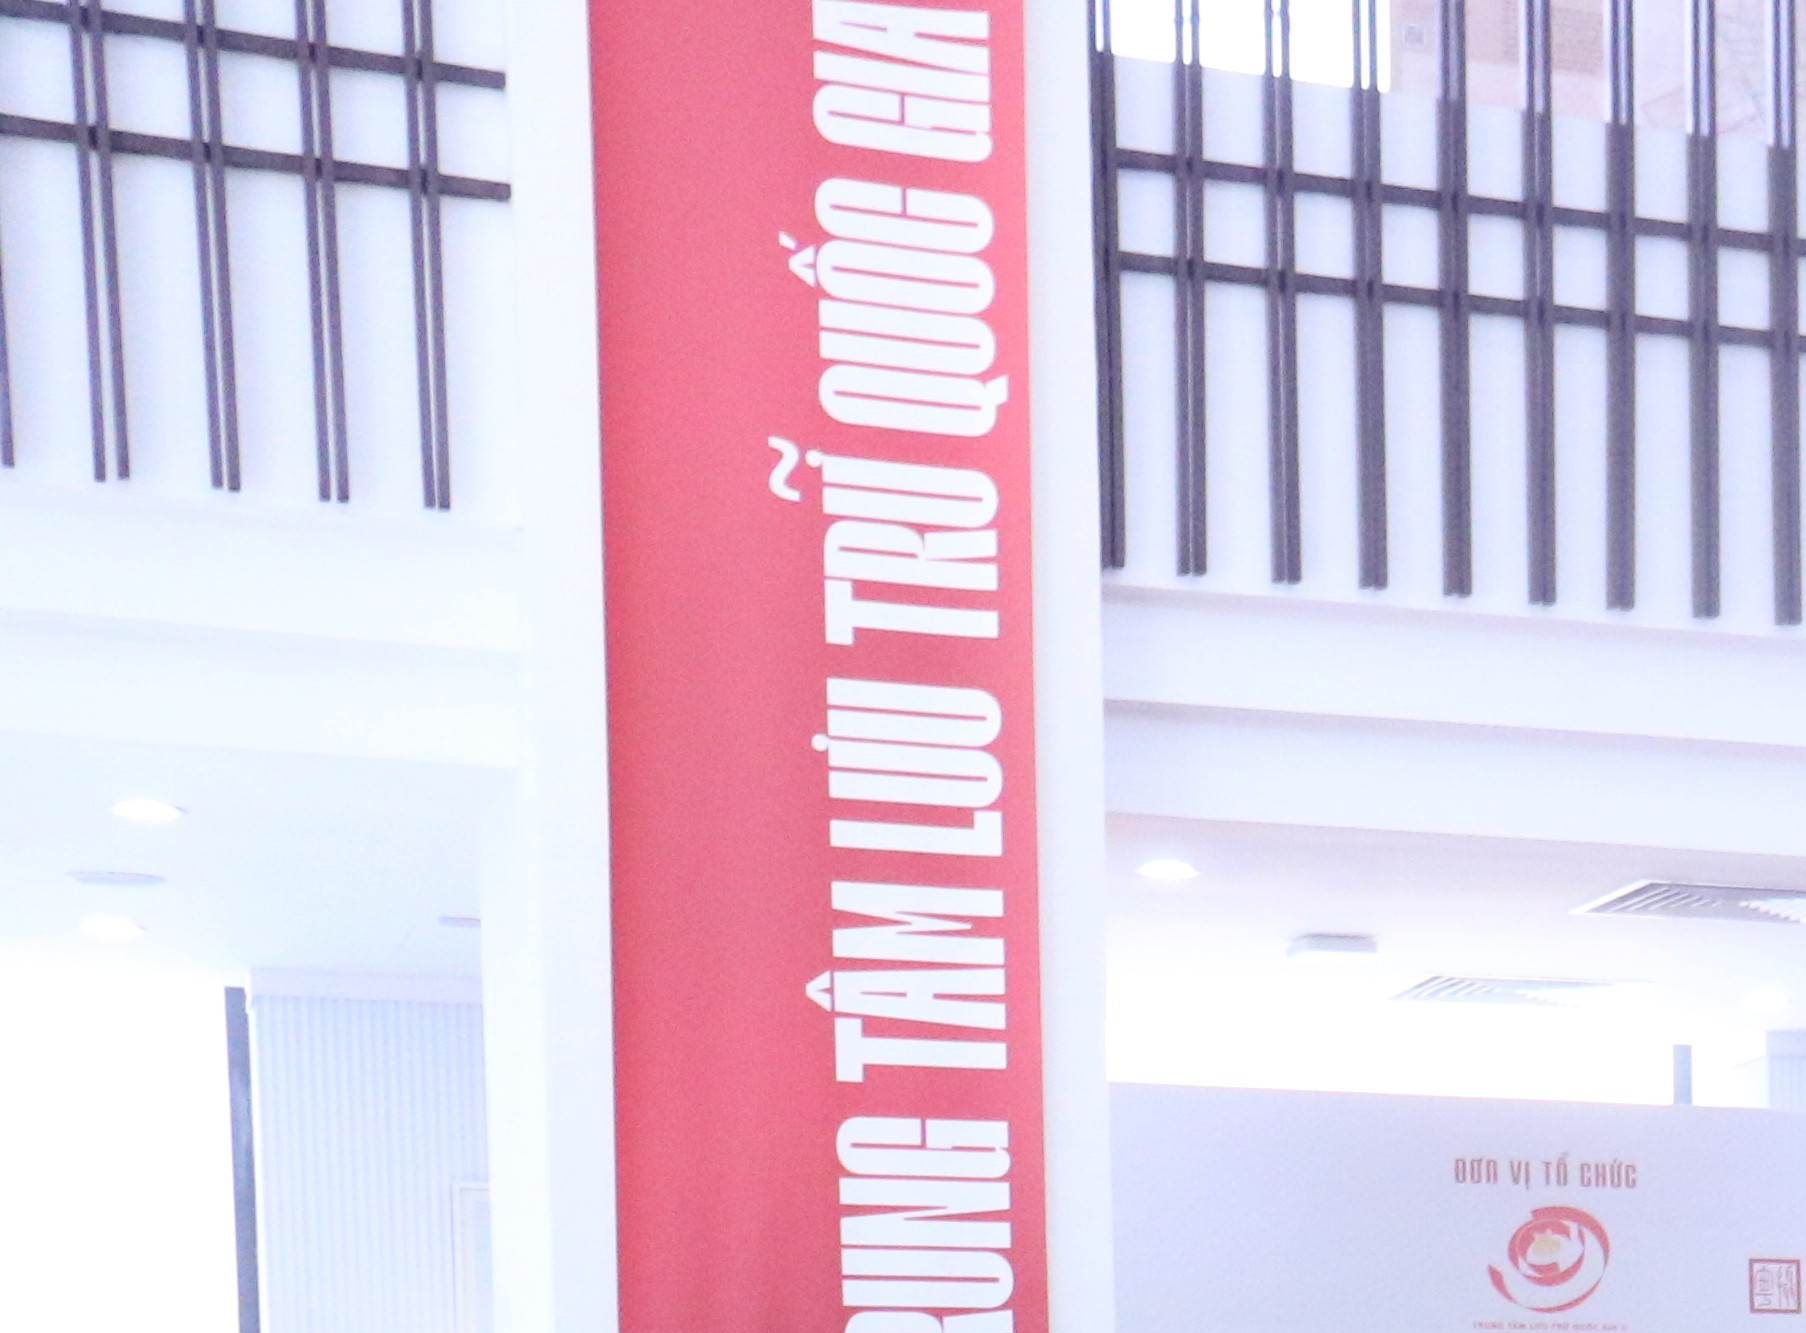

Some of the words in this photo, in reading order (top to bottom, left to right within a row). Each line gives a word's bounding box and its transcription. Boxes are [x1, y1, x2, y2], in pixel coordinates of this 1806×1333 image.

[811, 0, 992, 162] GIA
[779, 178, 1008, 437] QUỐC
[768, 437, 999, 646] TRỮ
[812, 677, 1002, 855] LƯU
[806, 879, 1006, 1083] TÂM
